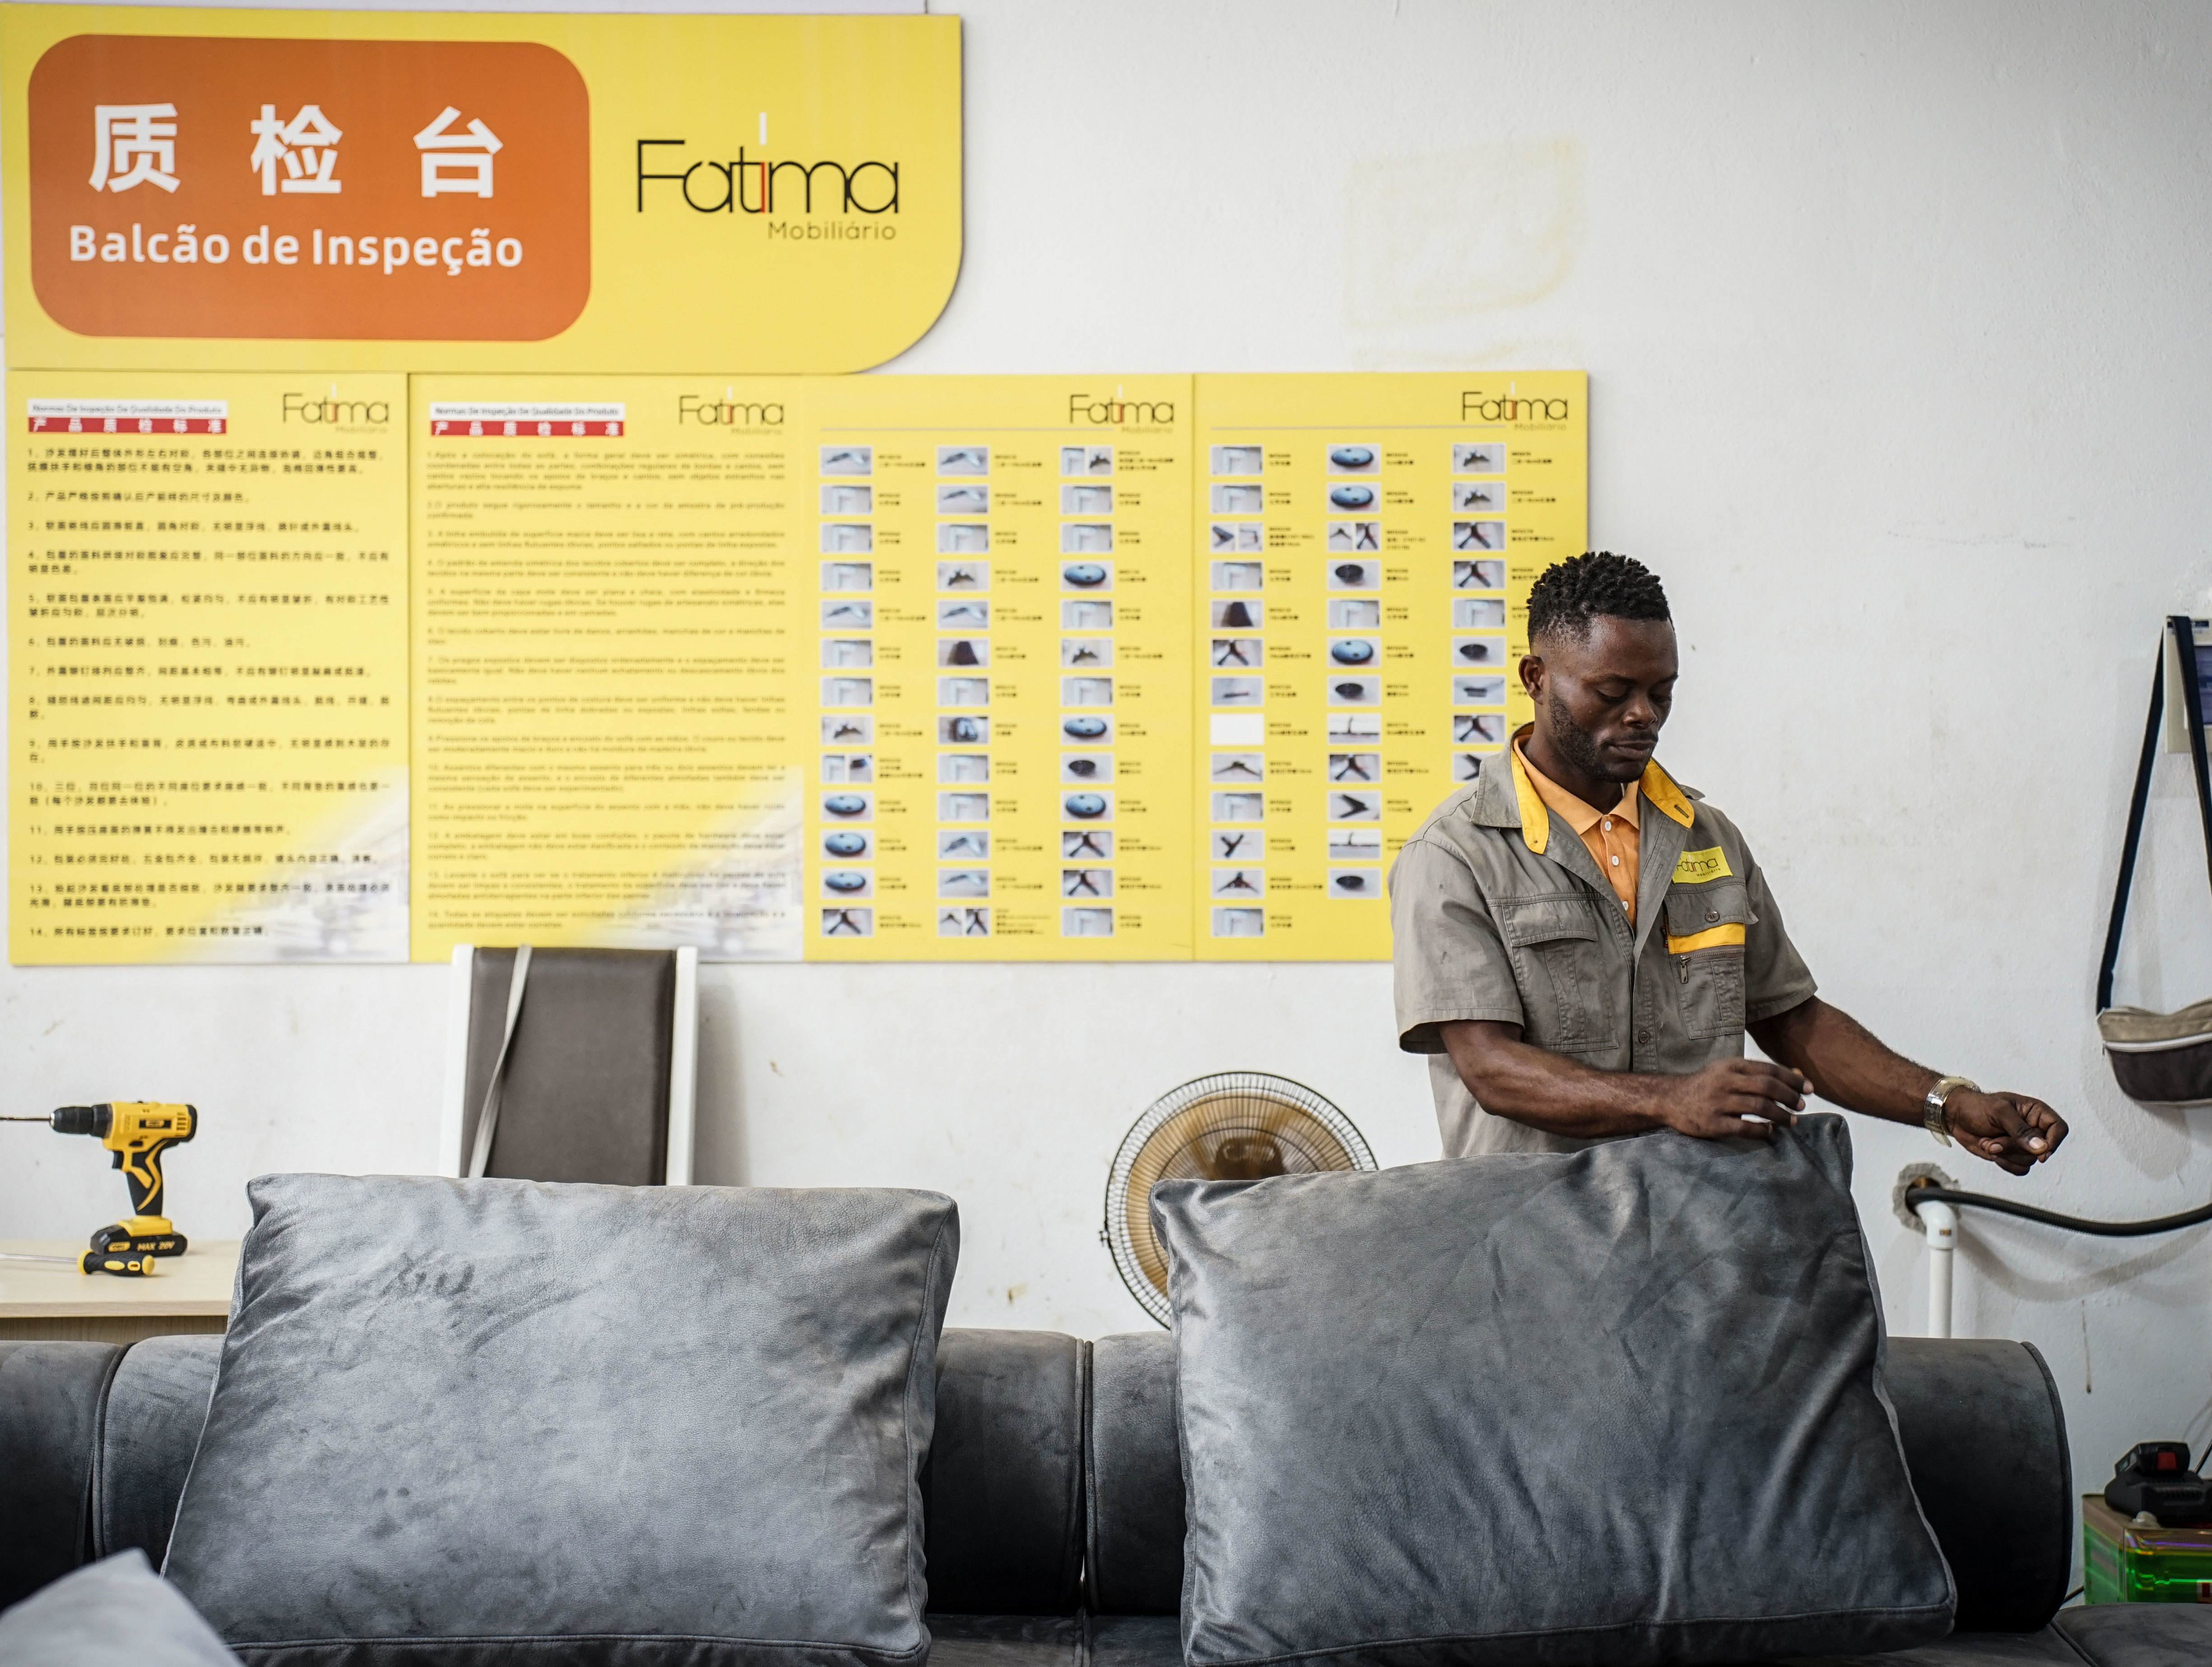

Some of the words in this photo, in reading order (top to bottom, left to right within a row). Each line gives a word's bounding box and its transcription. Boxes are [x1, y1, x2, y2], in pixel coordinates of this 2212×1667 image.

[89, 103, 502, 198] 质检台
[769, 222, 897, 241] Mobiliário
[70, 224, 229, 265] Balcão
[243, 225, 299, 265] de
[313, 228, 523, 276] Inspeção
[137, 1243, 156, 1251] MAX
